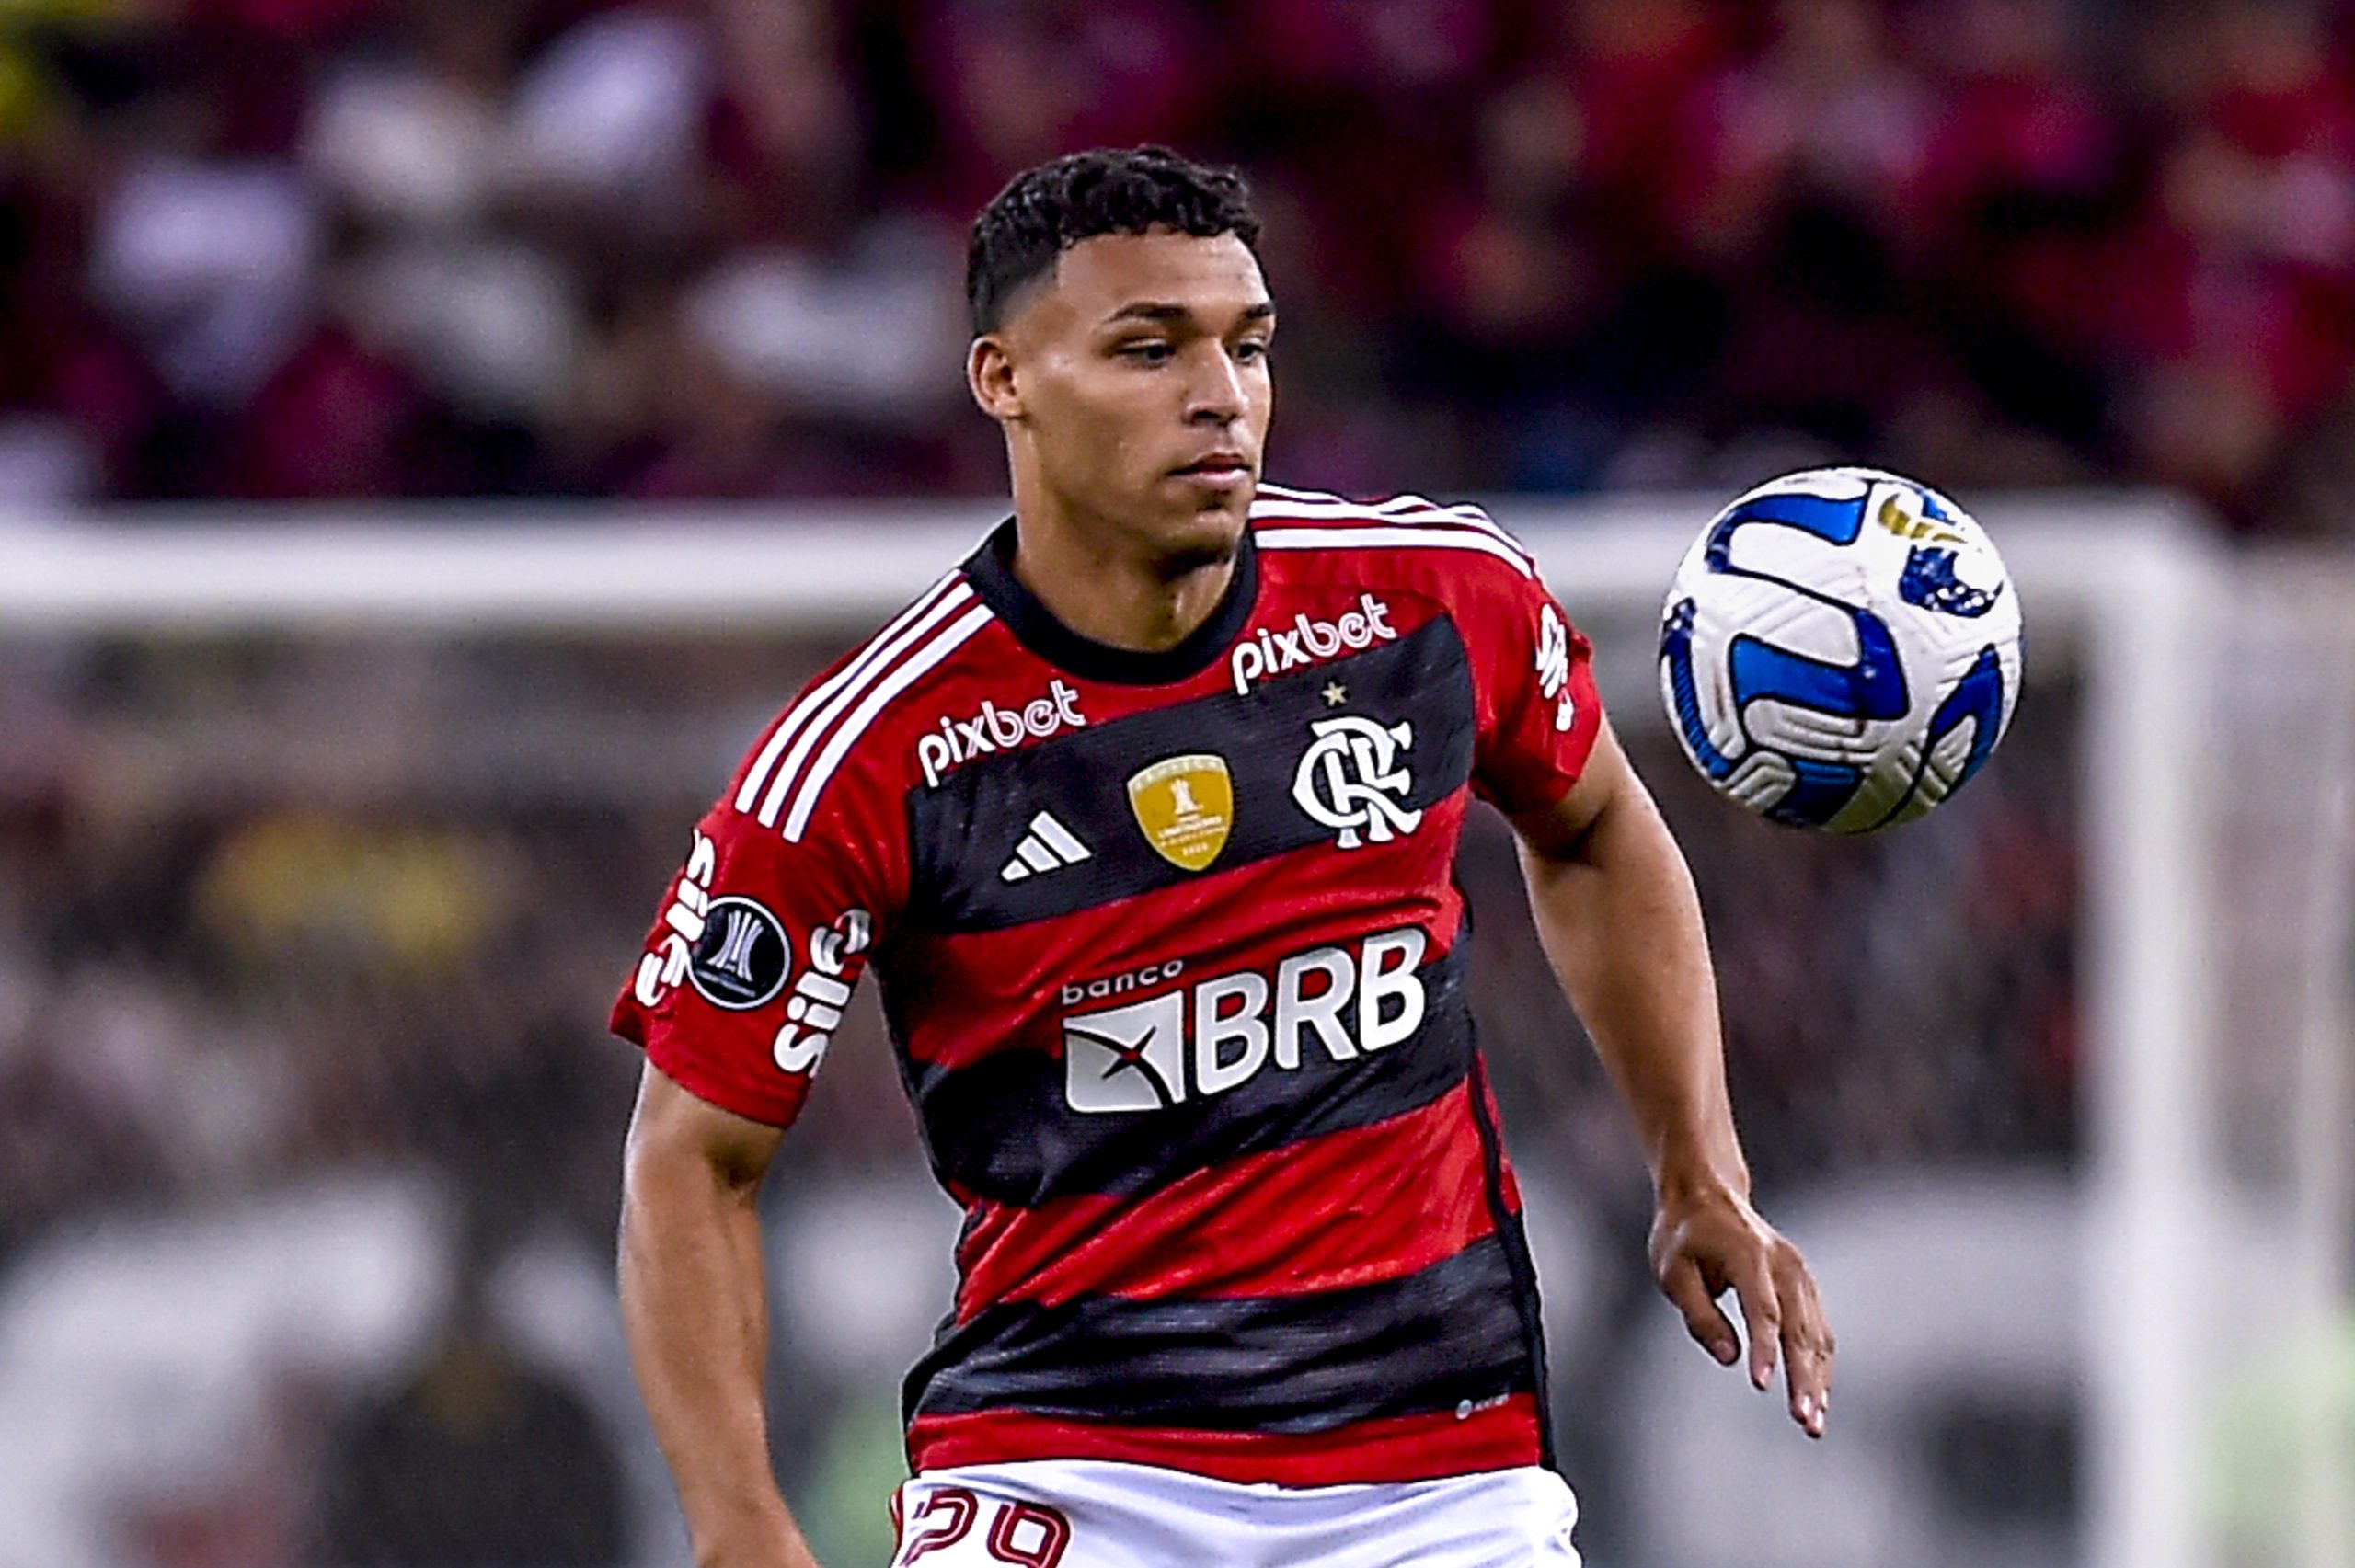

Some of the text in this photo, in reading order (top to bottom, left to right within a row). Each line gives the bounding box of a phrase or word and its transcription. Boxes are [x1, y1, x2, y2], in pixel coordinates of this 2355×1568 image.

[1231, 593, 1397, 696] pixbet
[918, 679, 1086, 788] pixbet
[1062, 959, 1184, 1006] banco
[1196, 928, 1426, 1094] BRB
